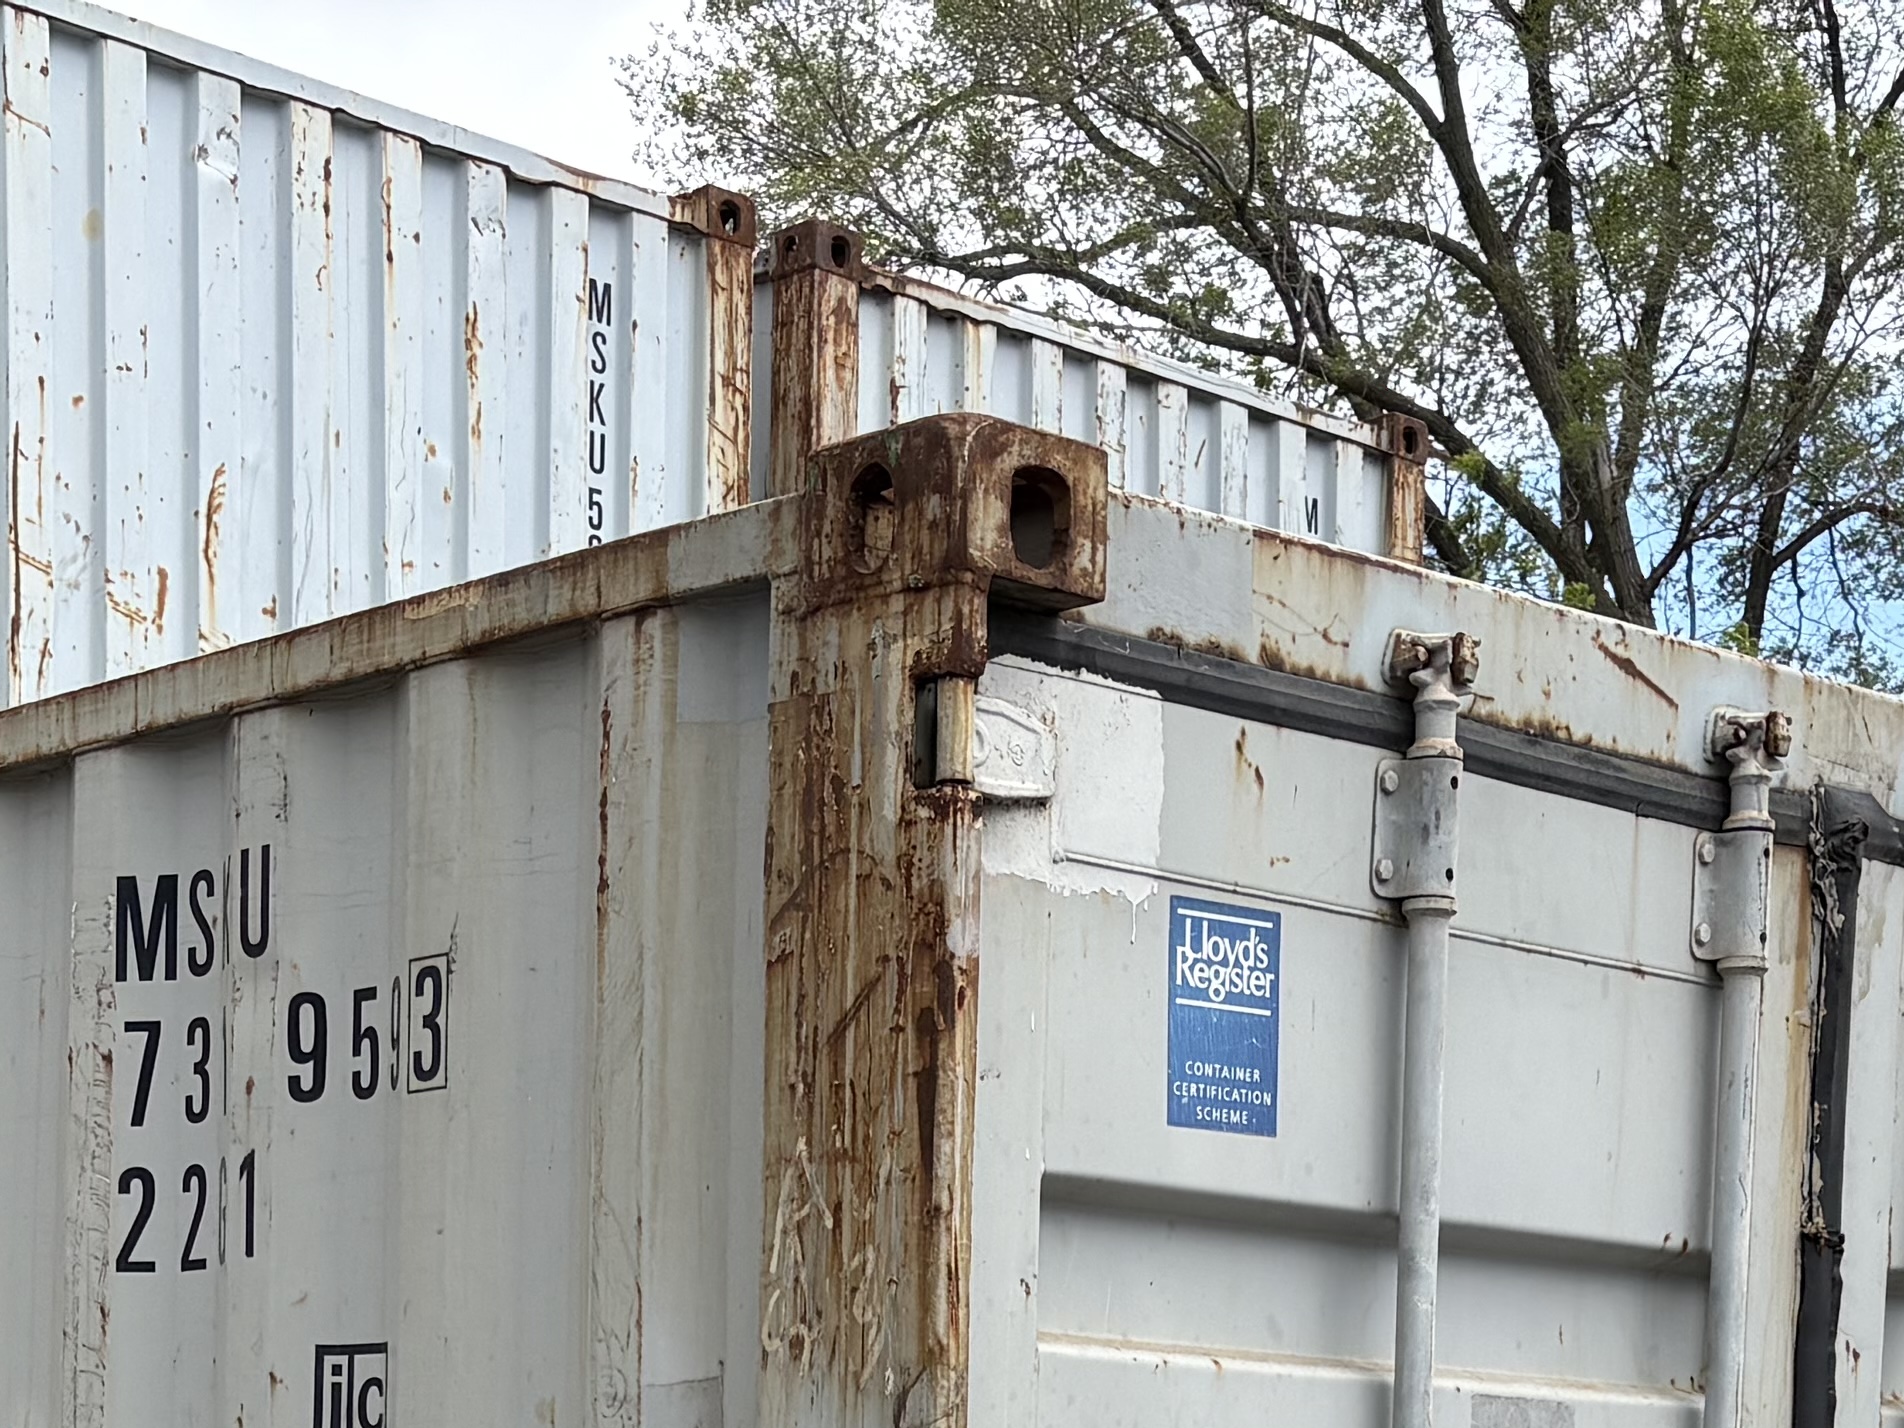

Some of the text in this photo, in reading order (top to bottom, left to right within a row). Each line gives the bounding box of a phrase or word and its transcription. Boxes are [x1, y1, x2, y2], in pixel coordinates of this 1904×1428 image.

[588, 278, 612, 474] MSKU
[116, 843, 271, 982] MSKU
[1185, 917, 1269, 972] Lloyd's
[1175, 946, 1275, 1002] Register
[287, 975, 402, 1102] 959
[413, 965, 444, 1082] 3
[1173, 1081, 1272, 1106] CERTIFICATION
[1185, 1060, 1261, 1083] CONTAINER
[1196, 1105, 1248, 1125] SCHEME
